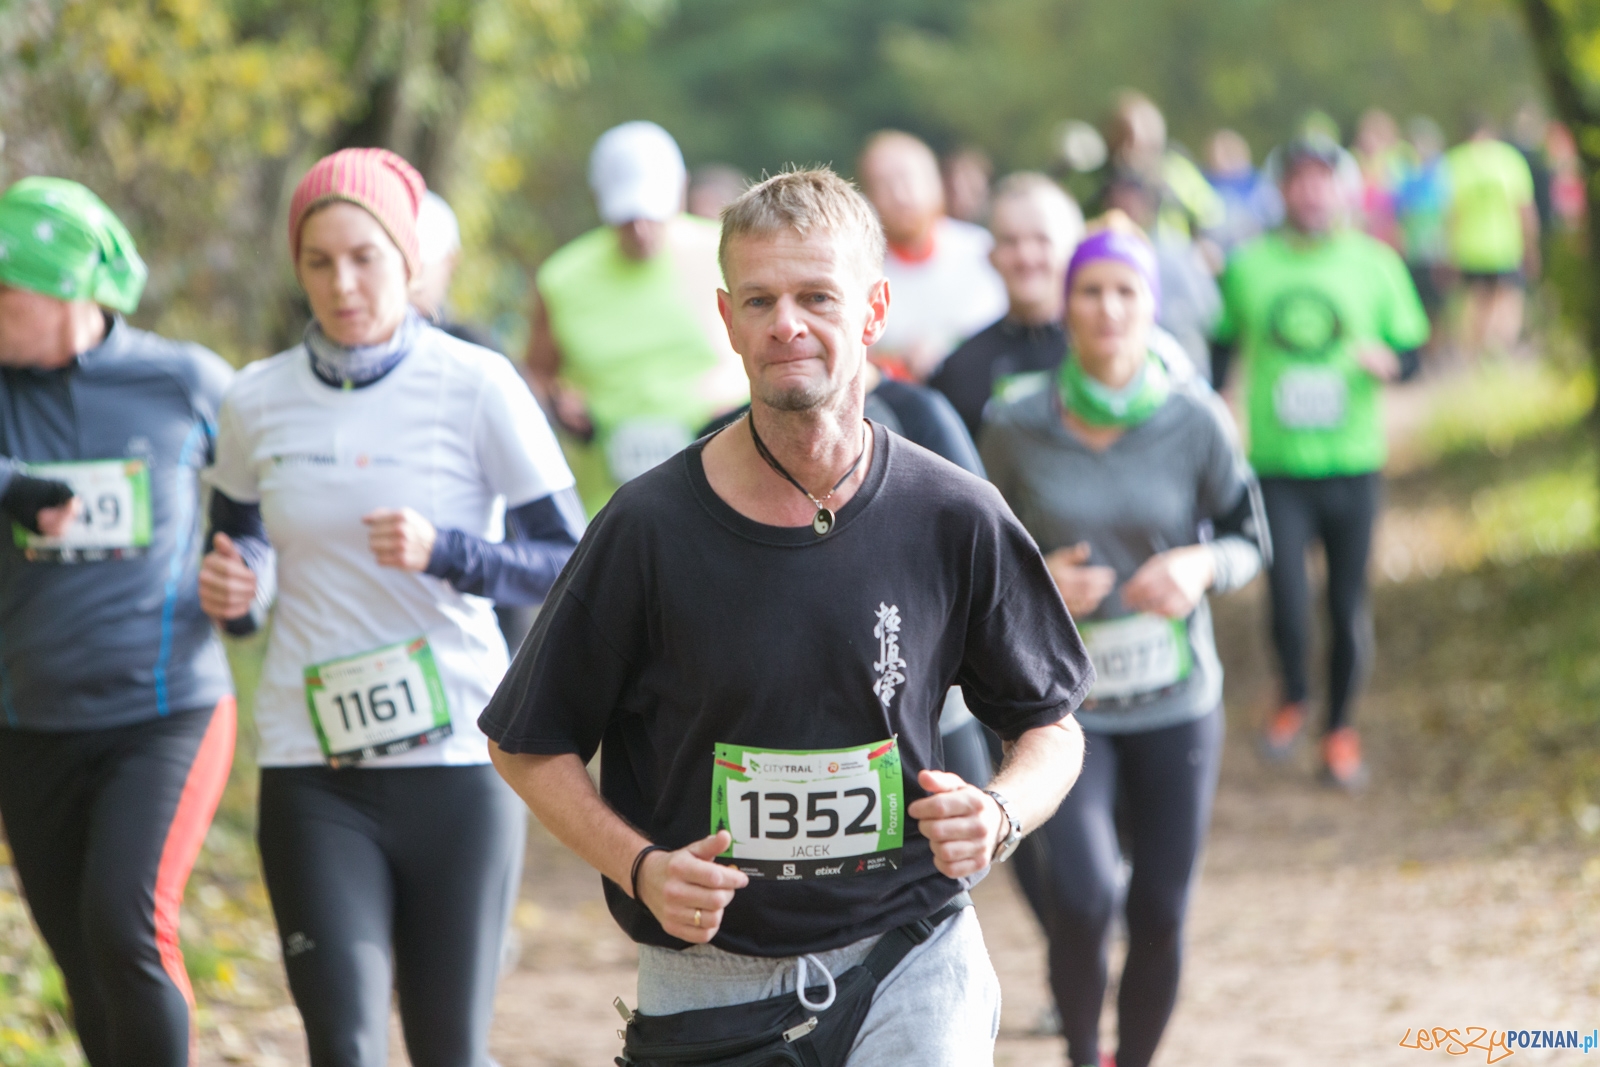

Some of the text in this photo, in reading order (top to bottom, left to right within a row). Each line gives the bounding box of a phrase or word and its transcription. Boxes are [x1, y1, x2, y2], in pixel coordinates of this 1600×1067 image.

[332, 678, 416, 731] 1161
[740, 787, 876, 839] 1352
[887, 793, 897, 836] Poznań
[790, 844, 830, 858] JACEK
